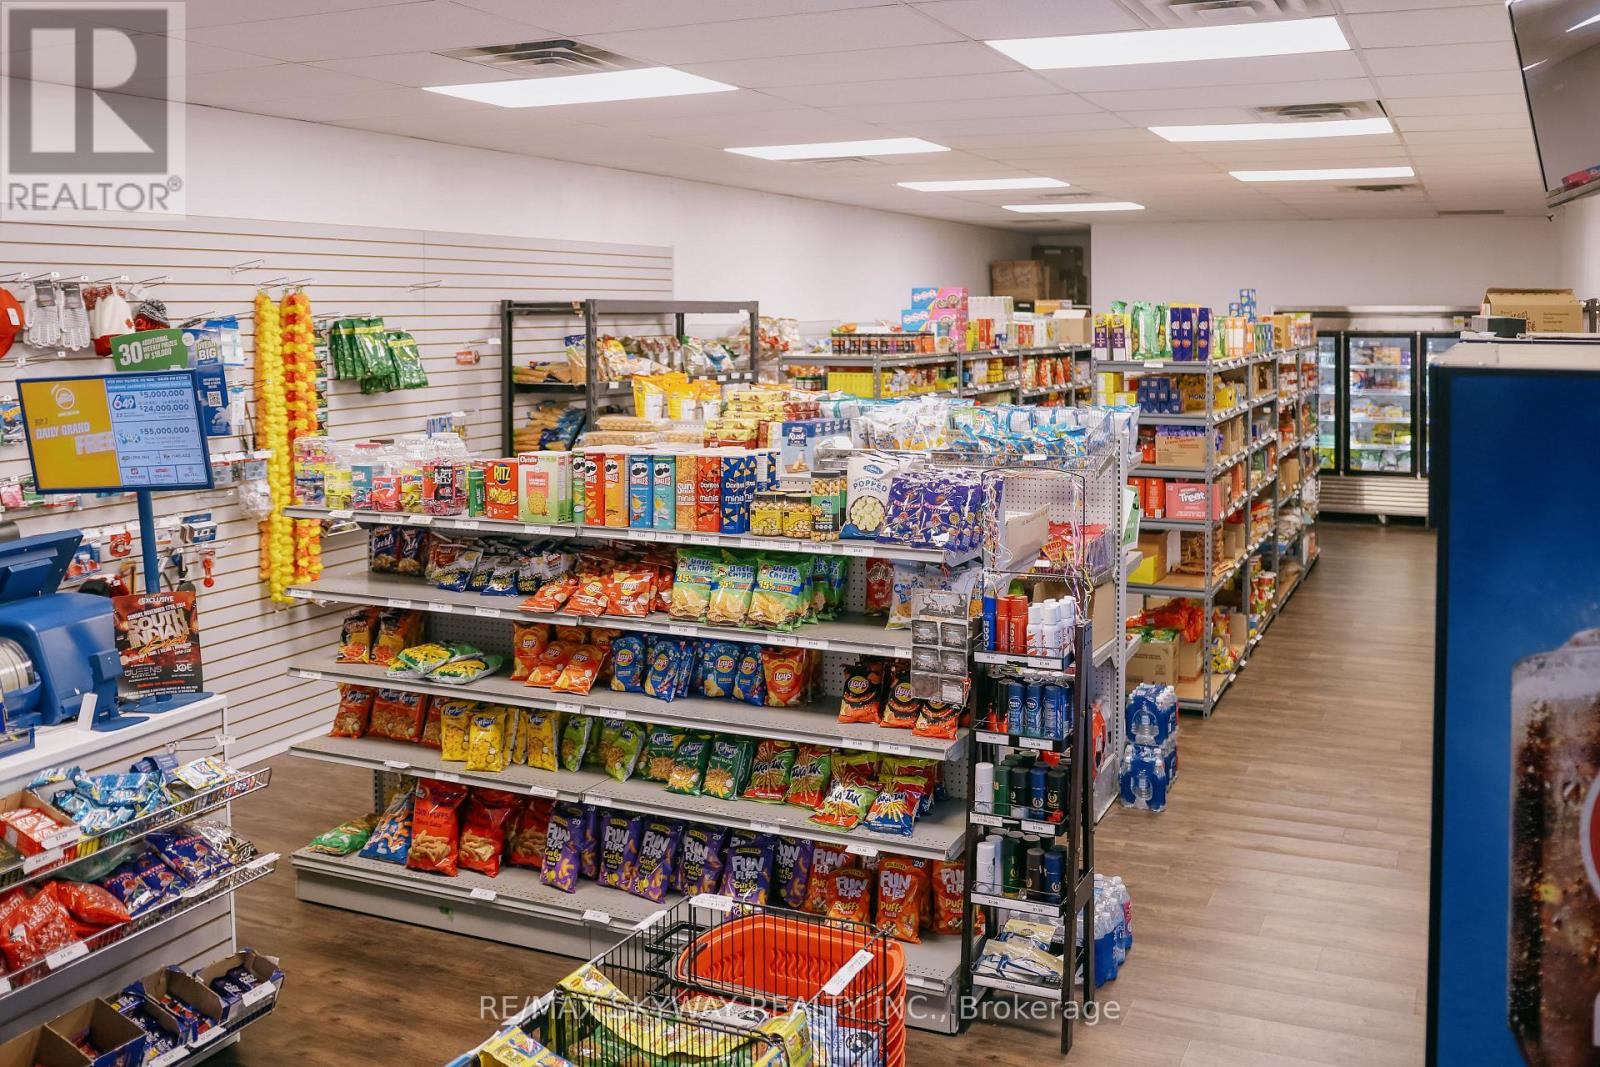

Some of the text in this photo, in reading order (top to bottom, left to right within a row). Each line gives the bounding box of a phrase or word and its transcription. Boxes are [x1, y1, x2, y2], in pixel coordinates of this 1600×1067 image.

[118, 341, 143, 366] 30
[493, 465, 511, 481] RITZ
[853, 479, 888, 492] POPPED
[725, 494, 744, 503] minis
[773, 565, 798, 575] Uncle
[141, 595, 175, 603] EXCLUSIVE
[128, 608, 186, 632] SOUTH
[128, 625, 190, 649] INDIAN
[124, 665, 163, 677] QUEENS
[548, 822, 571, 842] FUN
[605, 825, 630, 843] FUN
[712, 833, 721, 841] 20
[547, 839, 563, 850] FLIPS
[605, 840, 624, 853] FLIPS
[641, 830, 671, 852] FUN
[684, 837, 709, 859] FUN
[642, 845, 663, 860] FLIPS
[685, 853, 705, 866] FLIPS
[813, 848, 844, 867] FUN
[731, 855, 765, 872] FUN
[914, 860, 924, 868] 20
[735, 870, 759, 881] FLIPS
[880, 870, 912, 891] FUN
[835, 875, 869, 894] FUN
[838, 887, 863, 899] FLIPS
